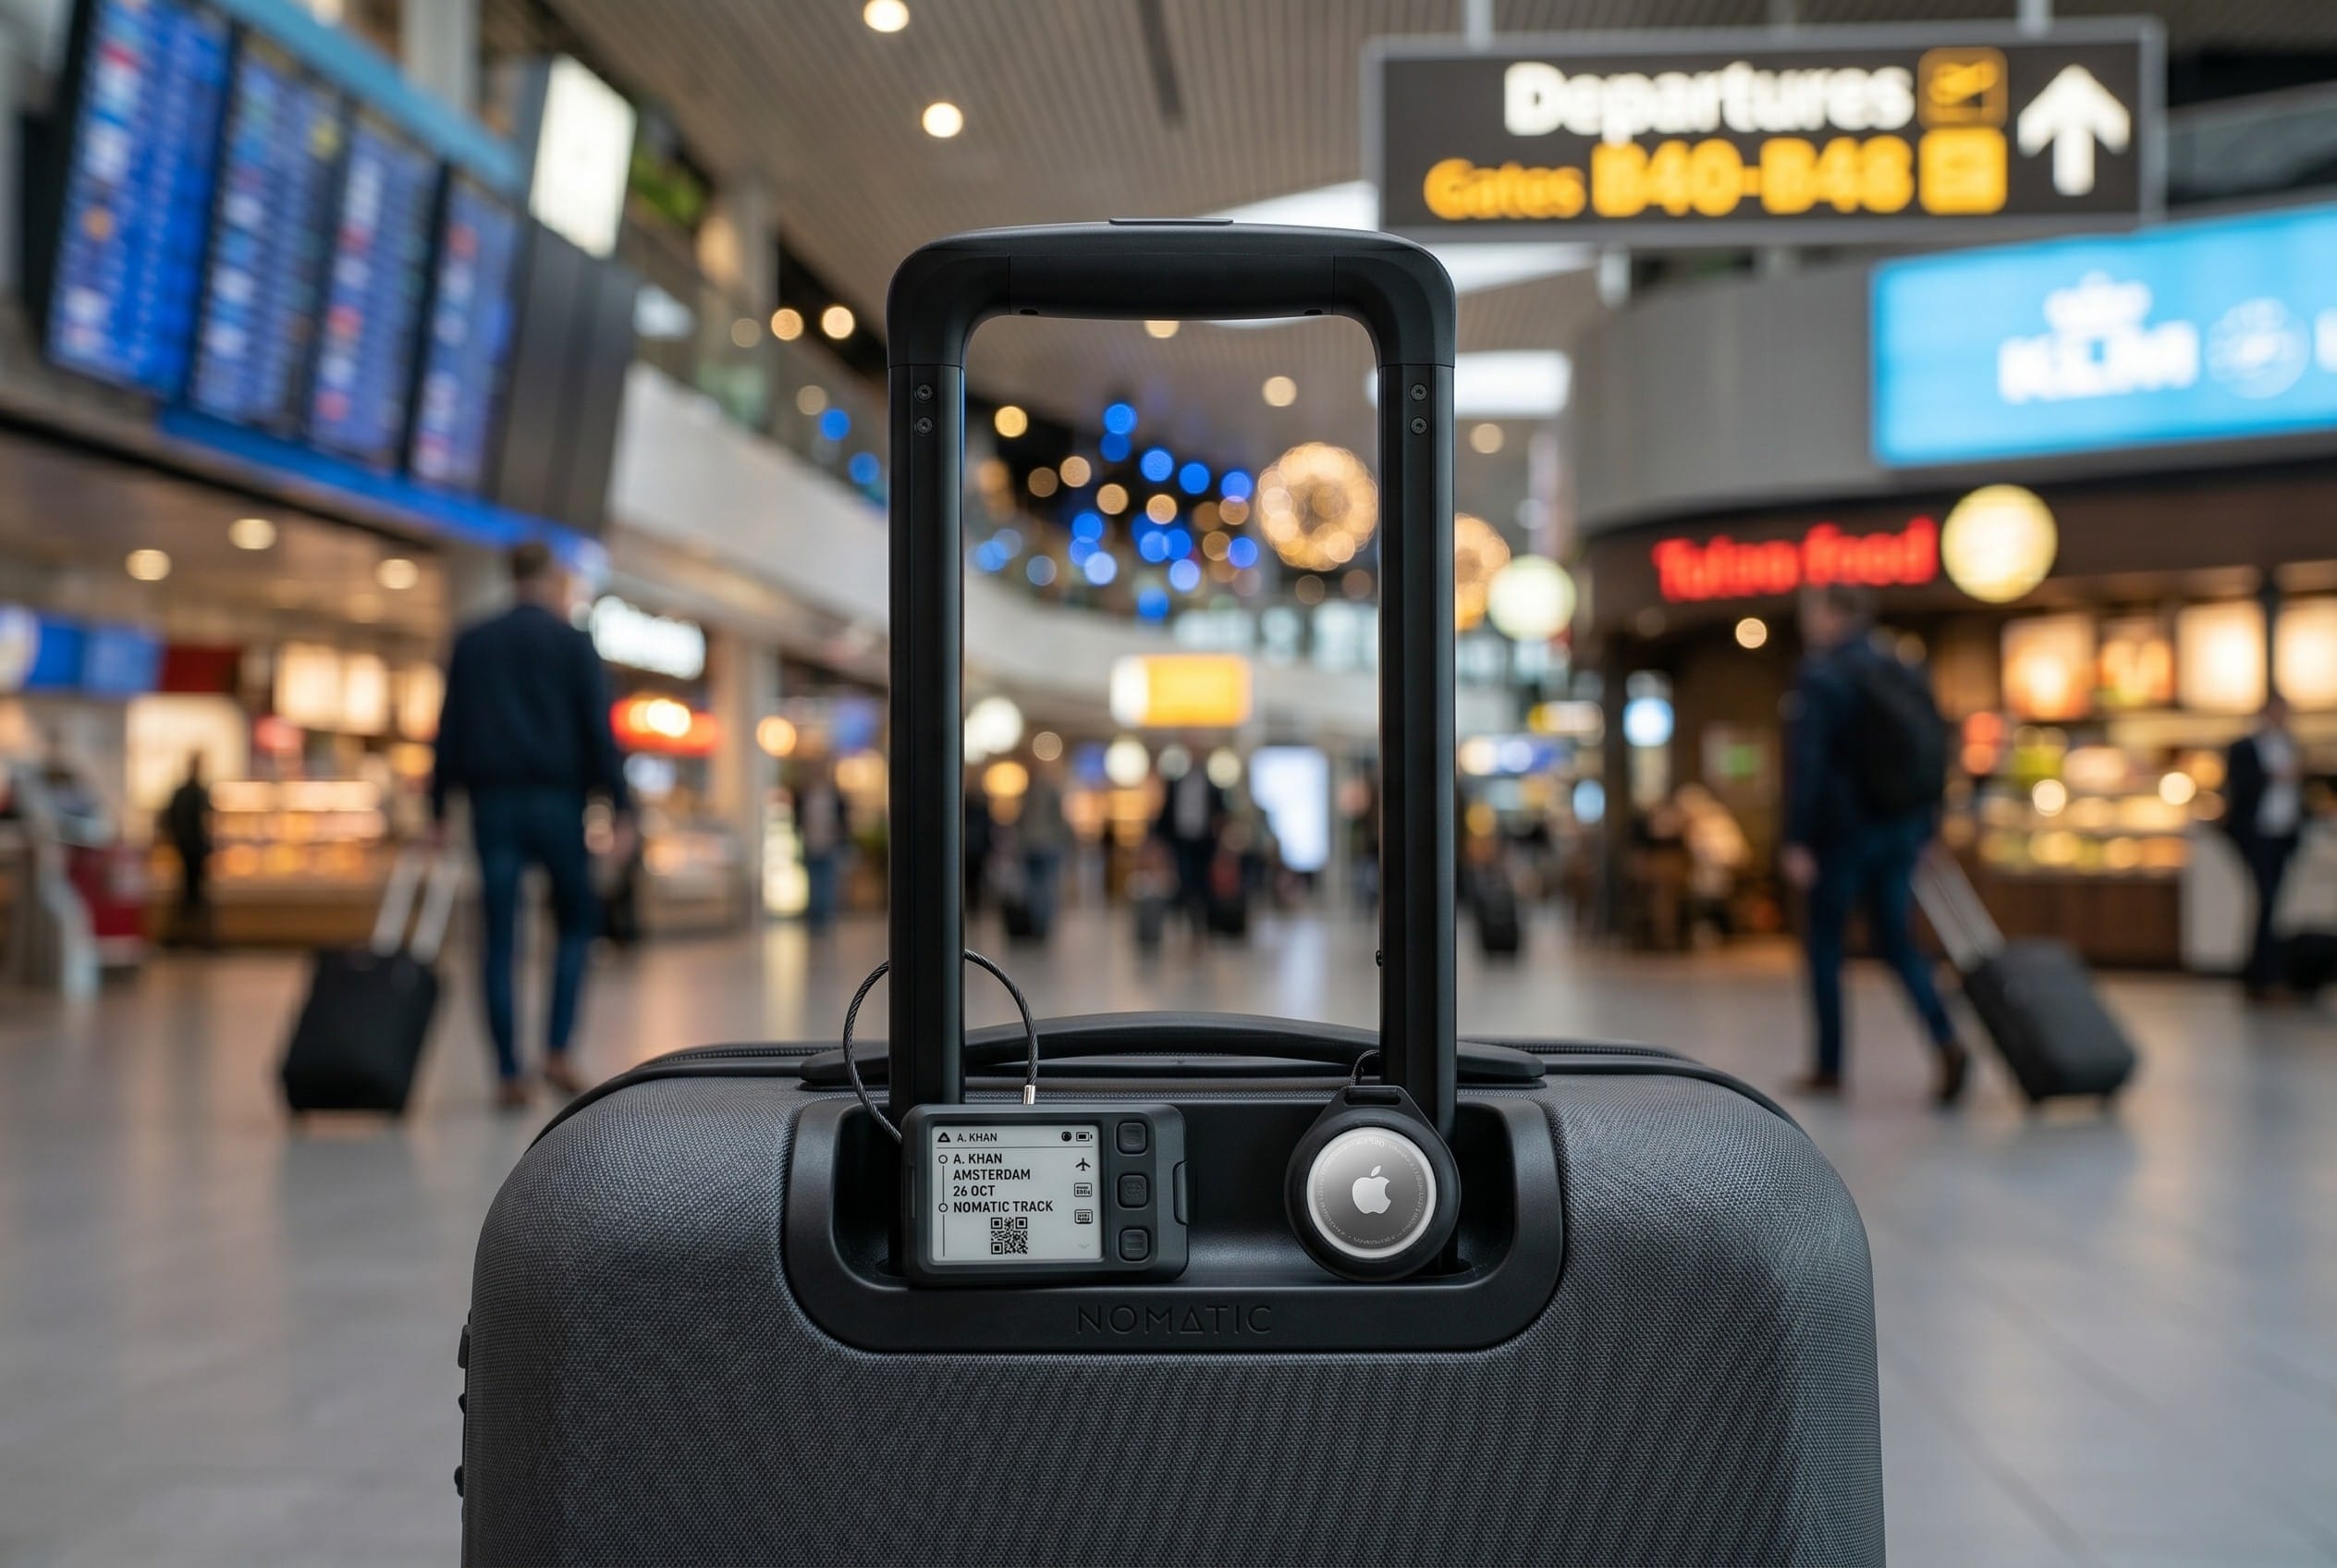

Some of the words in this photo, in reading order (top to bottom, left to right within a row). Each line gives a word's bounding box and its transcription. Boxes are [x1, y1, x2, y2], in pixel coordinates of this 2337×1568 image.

[1504, 60, 1915, 146] Departures
[957, 1133, 966, 1142] A.
[970, 1133, 997, 1142] KHAN
[954, 1154, 964, 1164] A.
[969, 1154, 1002, 1164] KHAN
[953, 1169, 1030, 1181] AMSTERDAM
[954, 1185, 967, 1196] 26
[972, 1185, 995, 1196] OCT
[954, 1201, 1009, 1213] NOMATIC
[1013, 1201, 1053, 1212] TRACK
[1076, 1305, 1272, 1334] NOMATIC
